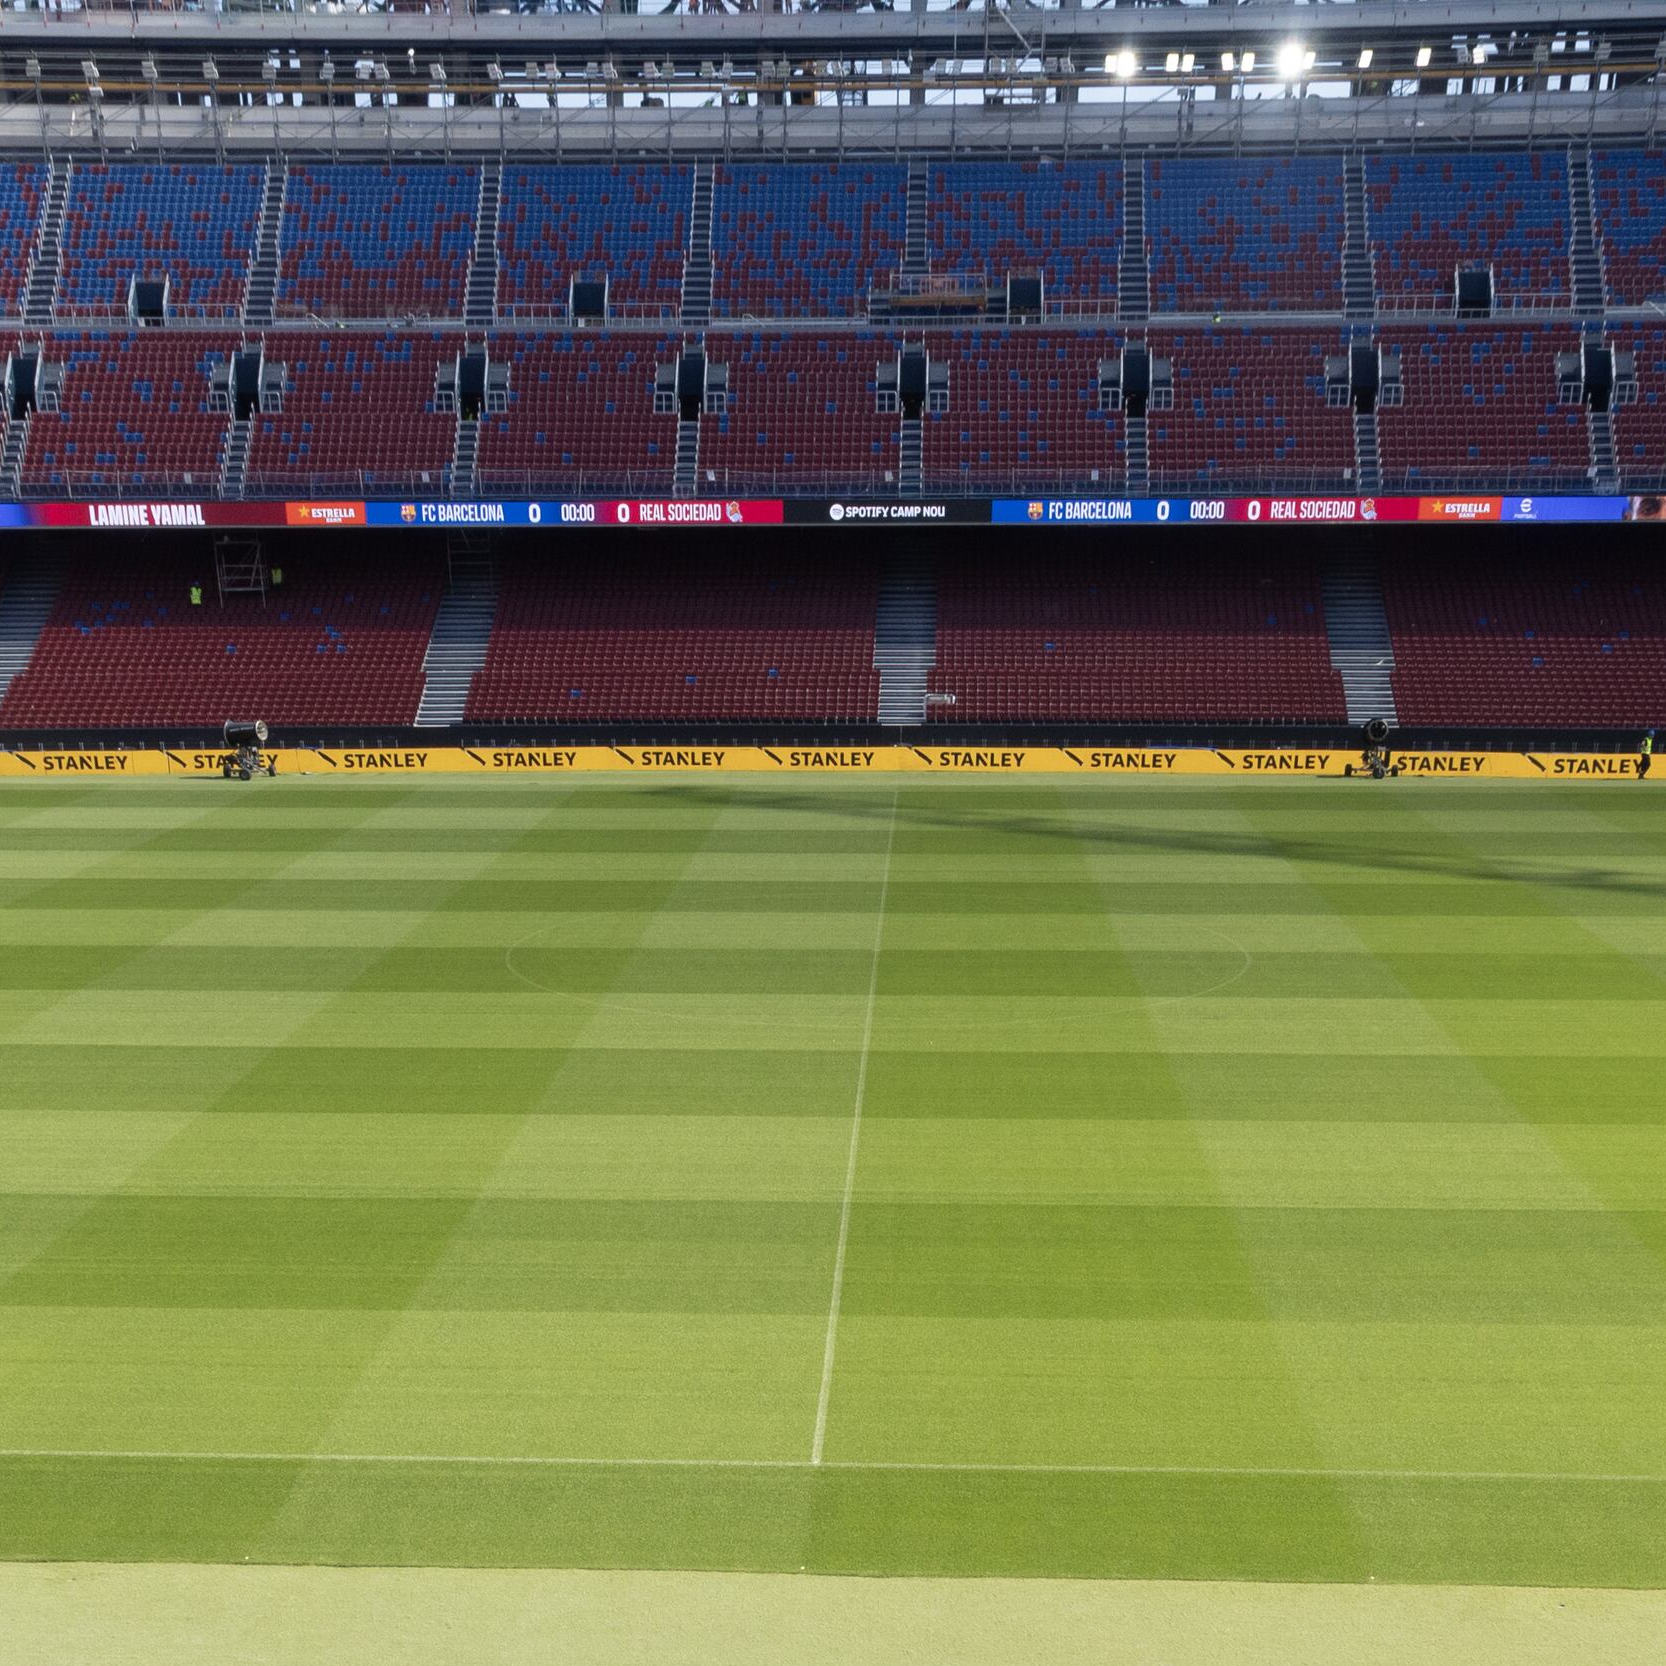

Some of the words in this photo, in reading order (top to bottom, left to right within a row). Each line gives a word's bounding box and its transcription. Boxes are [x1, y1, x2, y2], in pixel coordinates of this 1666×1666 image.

[89, 505, 148, 525] LAMINE
[151, 505, 205, 525] YAMAL
[312, 509, 355, 518] ESTRELLA
[422, 504, 435, 521] FC
[438, 505, 504, 521] BARCELONA
[529, 504, 540, 522] 0
[562, 504, 594, 521] 00:00
[618, 504, 629, 522] 0
[640, 503, 666, 521] REAL
[668, 504, 721, 521] SOCIEDAD
[845, 506, 890, 518] SPOTIFY
[890, 506, 922, 518] CAMP
[923, 506, 946, 518] NOU
[1049, 502, 1062, 519] FC
[1066, 502, 1131, 519] BARCELONA
[1157, 501, 1169, 520] 0
[1191, 502, 1224, 518] 00:00
[1248, 501, 1260, 520] 0
[1271, 501, 1298, 519] REAL
[1300, 501, 1355, 518] SOCIEDAD
[1445, 504, 1490, 514] ESTRELLA
[42, 755, 128, 771] STANLEY
[193, 753, 279, 769] STAEY
[343, 752, 429, 768] STANLEY
[492, 751, 577, 767] STANLEY
[641, 751, 726, 766] STANLEY
[789, 751, 875, 767] STANLEY
[939, 751, 1025, 767] STANLEY
[1090, 753, 1177, 768] STANLEY
[1242, 754, 1331, 770] STANLEY
[1396, 756, 1486, 772] STANLEY
